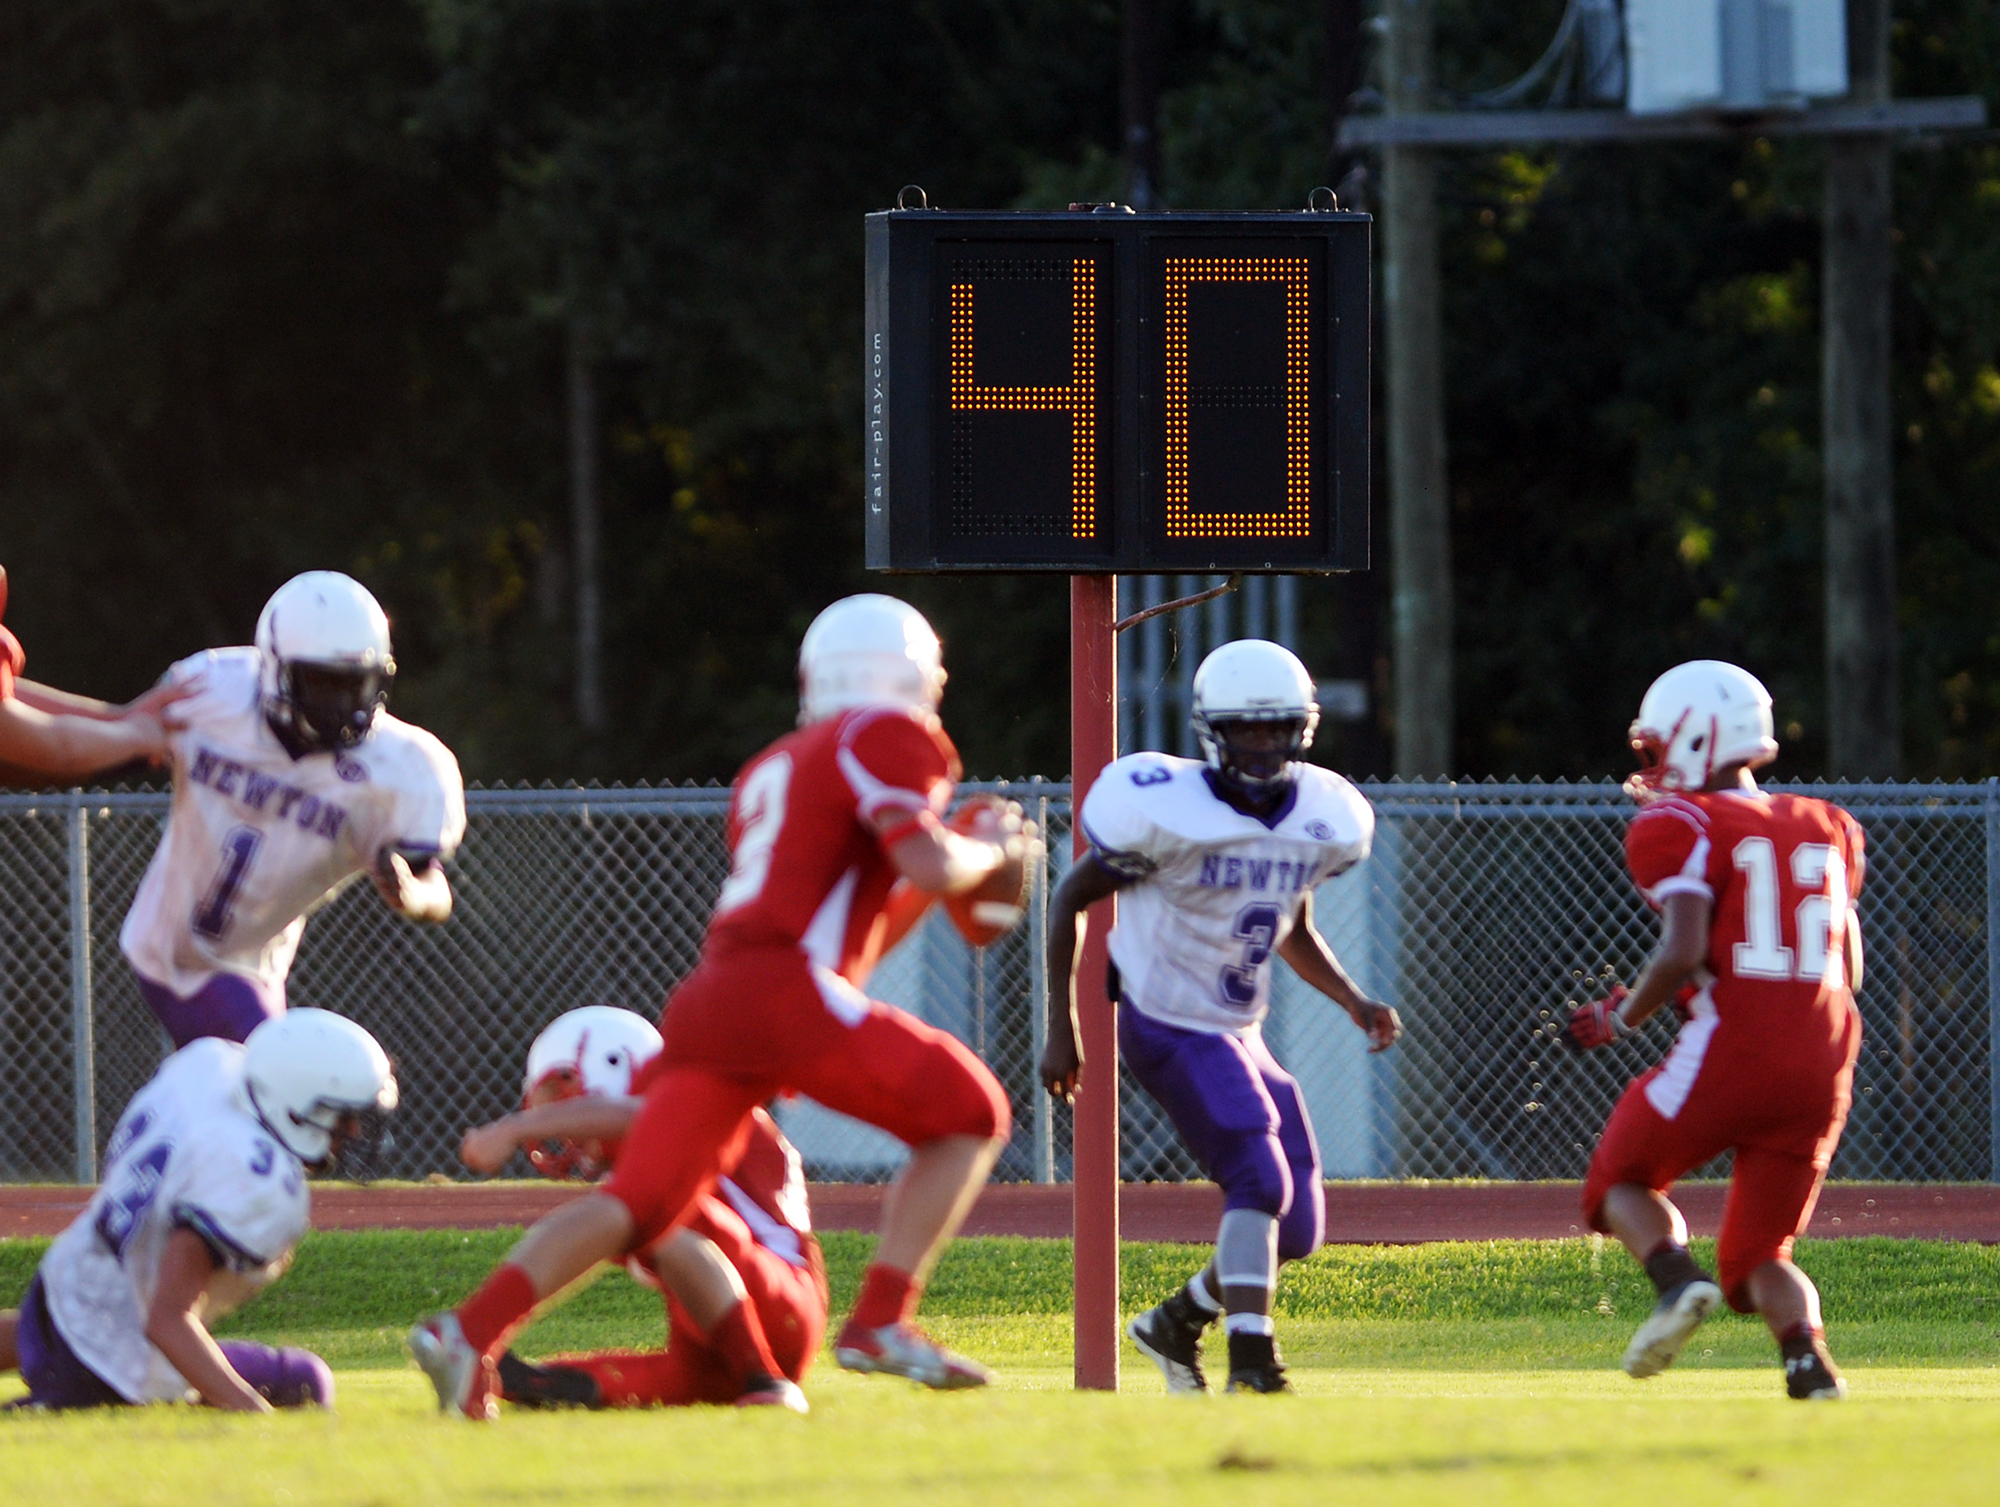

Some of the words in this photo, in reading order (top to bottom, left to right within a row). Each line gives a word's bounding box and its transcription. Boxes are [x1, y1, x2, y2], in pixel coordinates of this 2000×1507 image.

[871, 333, 883, 514] fair-play.com
[951, 257, 1311, 538] 40
[190, 746, 347, 842] NEWTON
[1129, 766, 1173, 788] 3
[192, 824, 263, 941] 1
[1732, 835, 1847, 990] 12
[1219, 901, 1283, 1005] 3
